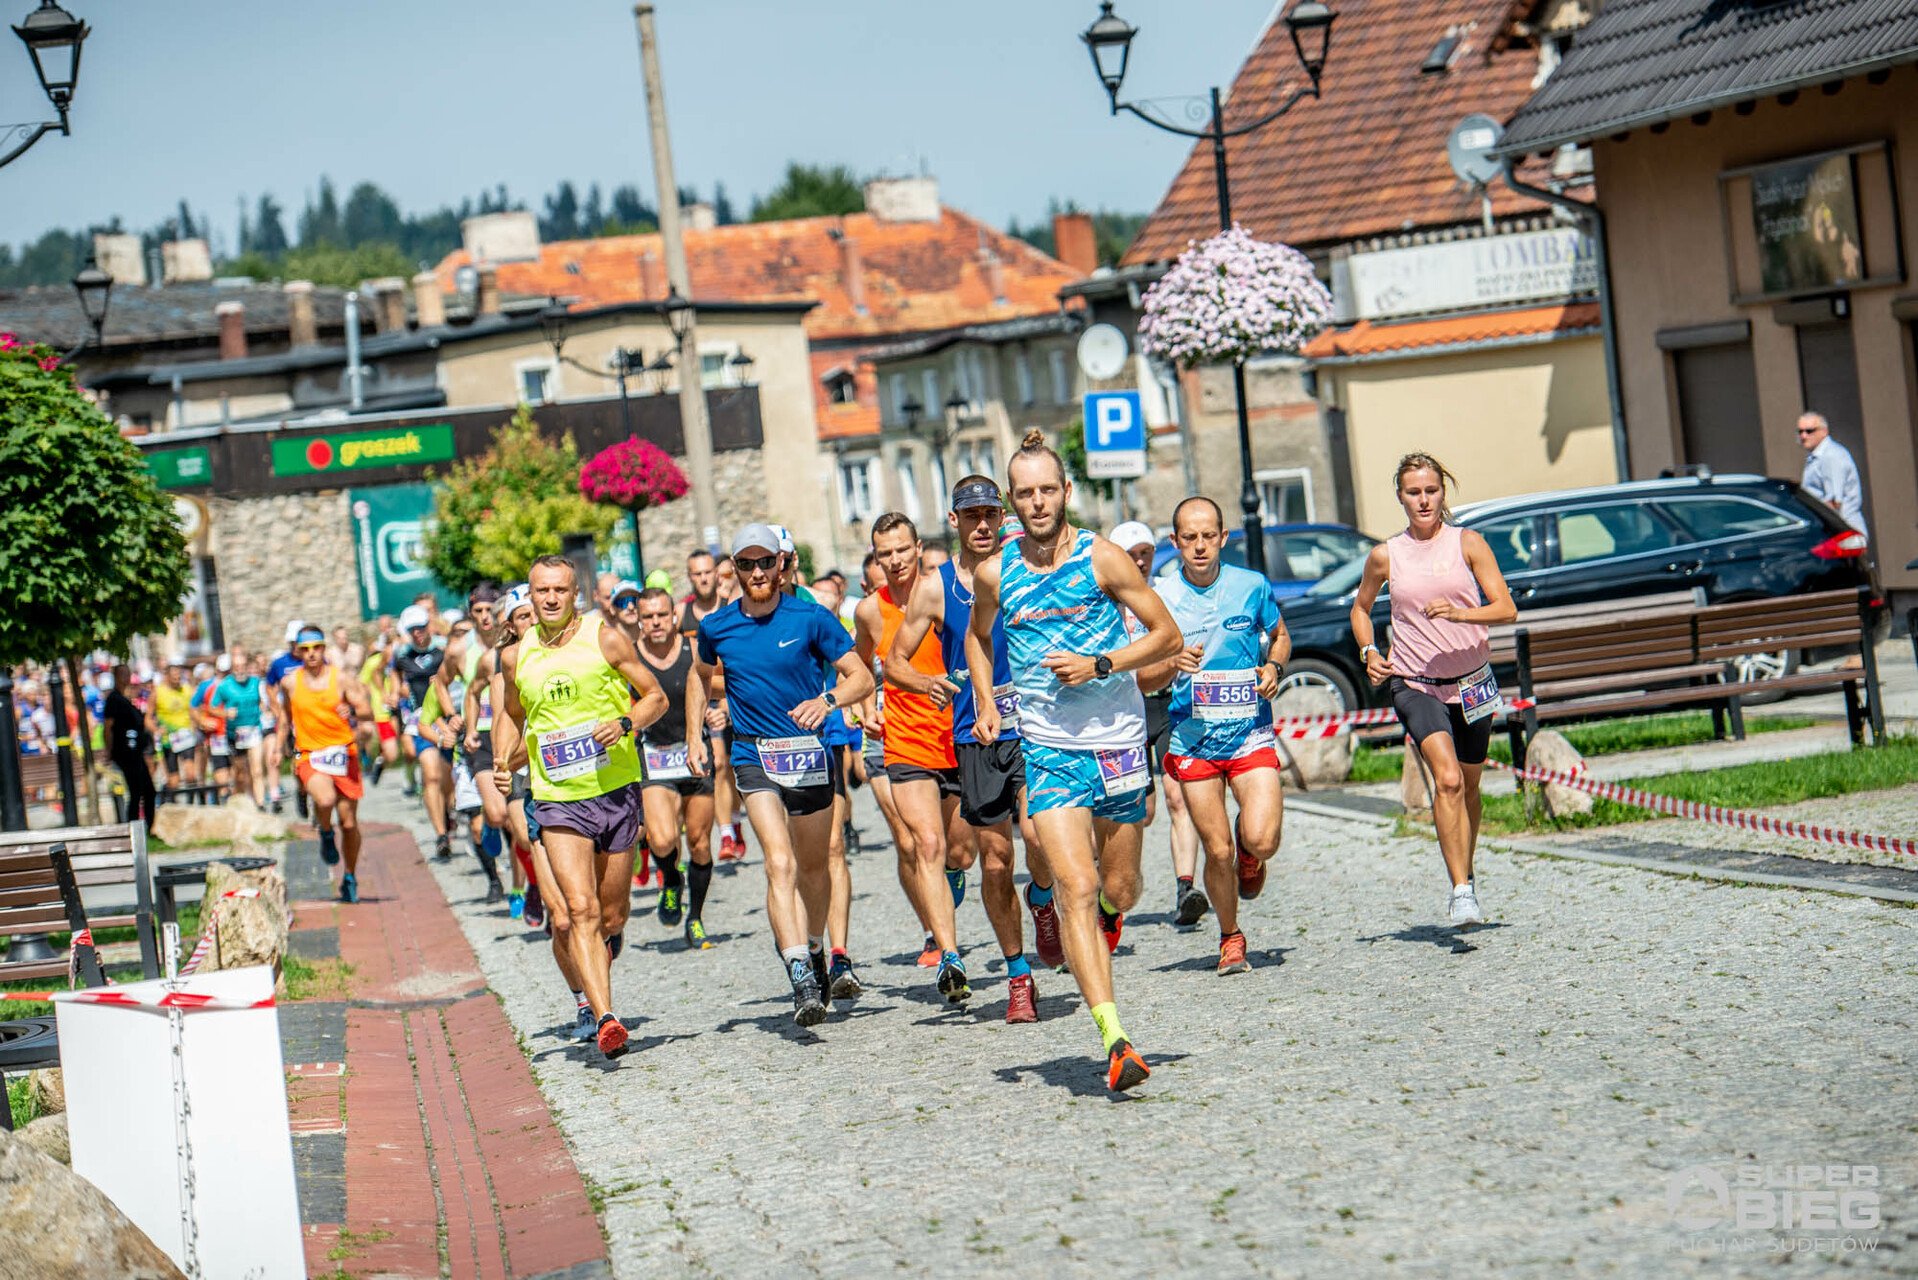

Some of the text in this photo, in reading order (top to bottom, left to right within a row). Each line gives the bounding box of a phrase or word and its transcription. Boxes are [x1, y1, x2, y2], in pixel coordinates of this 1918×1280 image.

[1096, 397, 1132, 446] P
[340, 432, 422, 466] groszek
[1219, 685, 1251, 703] 556
[564, 738, 597, 761] 511
[785, 753, 816, 771] 121
